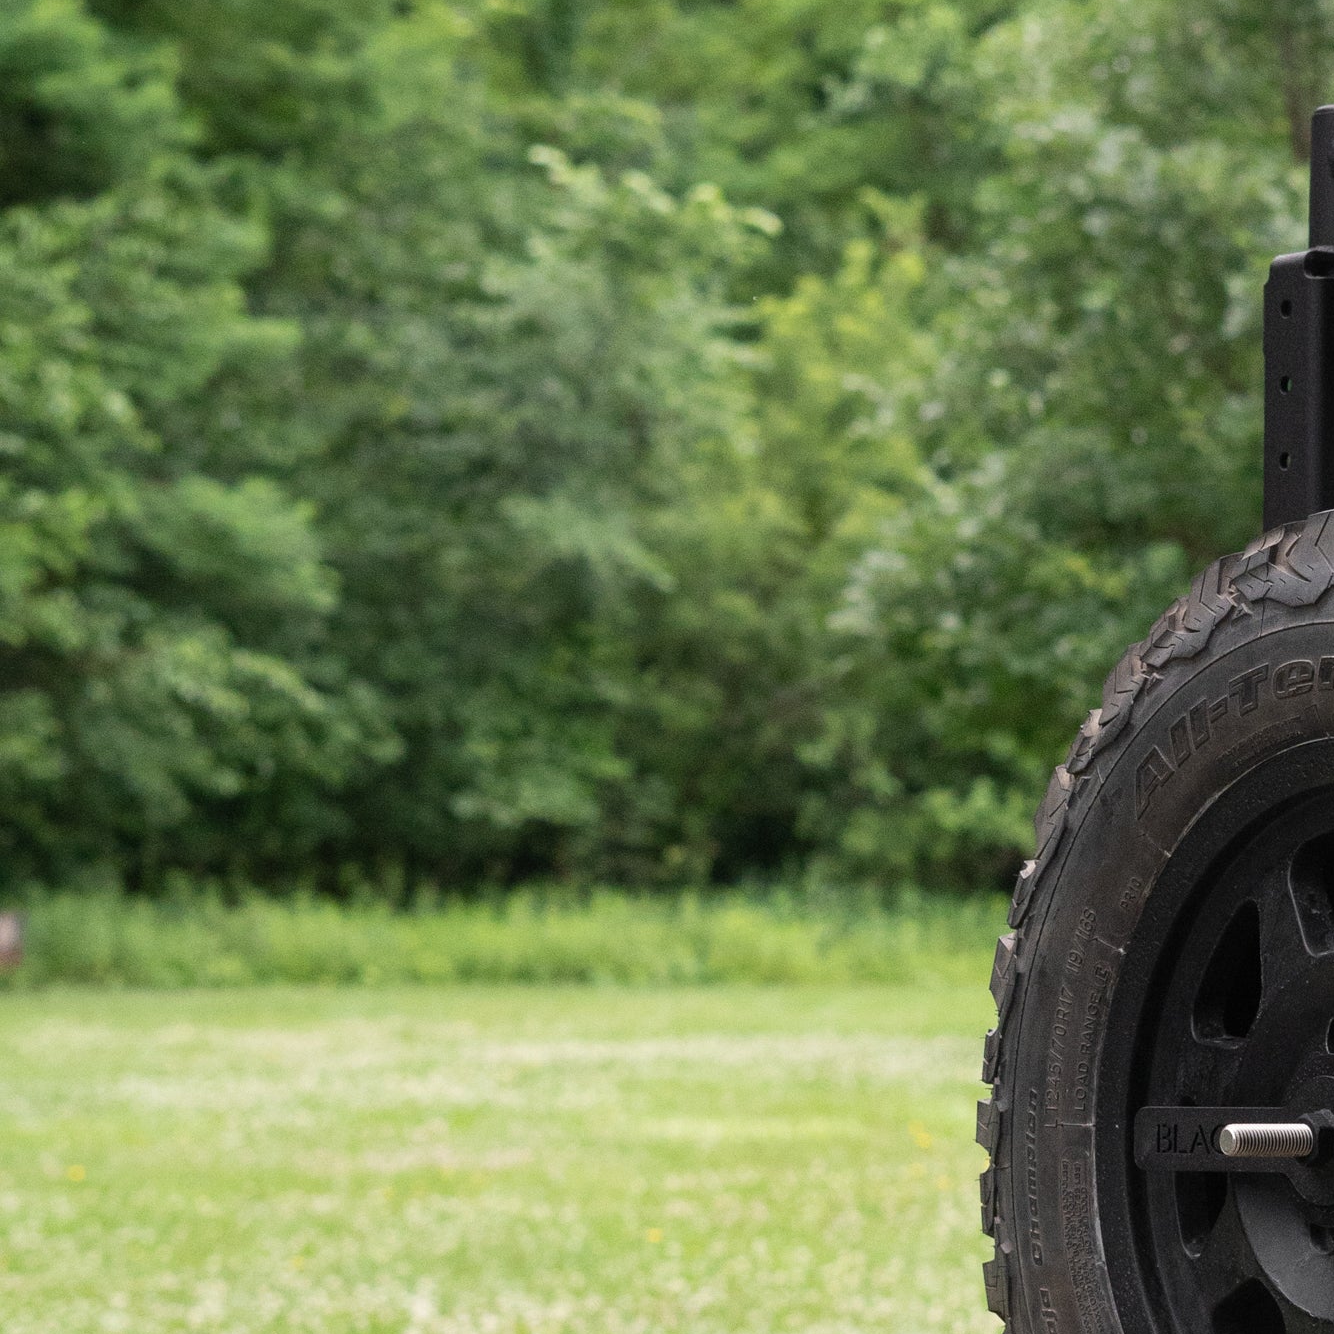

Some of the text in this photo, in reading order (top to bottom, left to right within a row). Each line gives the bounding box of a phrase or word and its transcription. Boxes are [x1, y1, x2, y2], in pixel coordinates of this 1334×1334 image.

[1079, 992, 1103, 1056] RANGE
[1073, 1061, 1090, 1111] LOAD
[1155, 1123, 1226, 1155] BLAC
[1024, 1087, 1044, 1267] Champion
